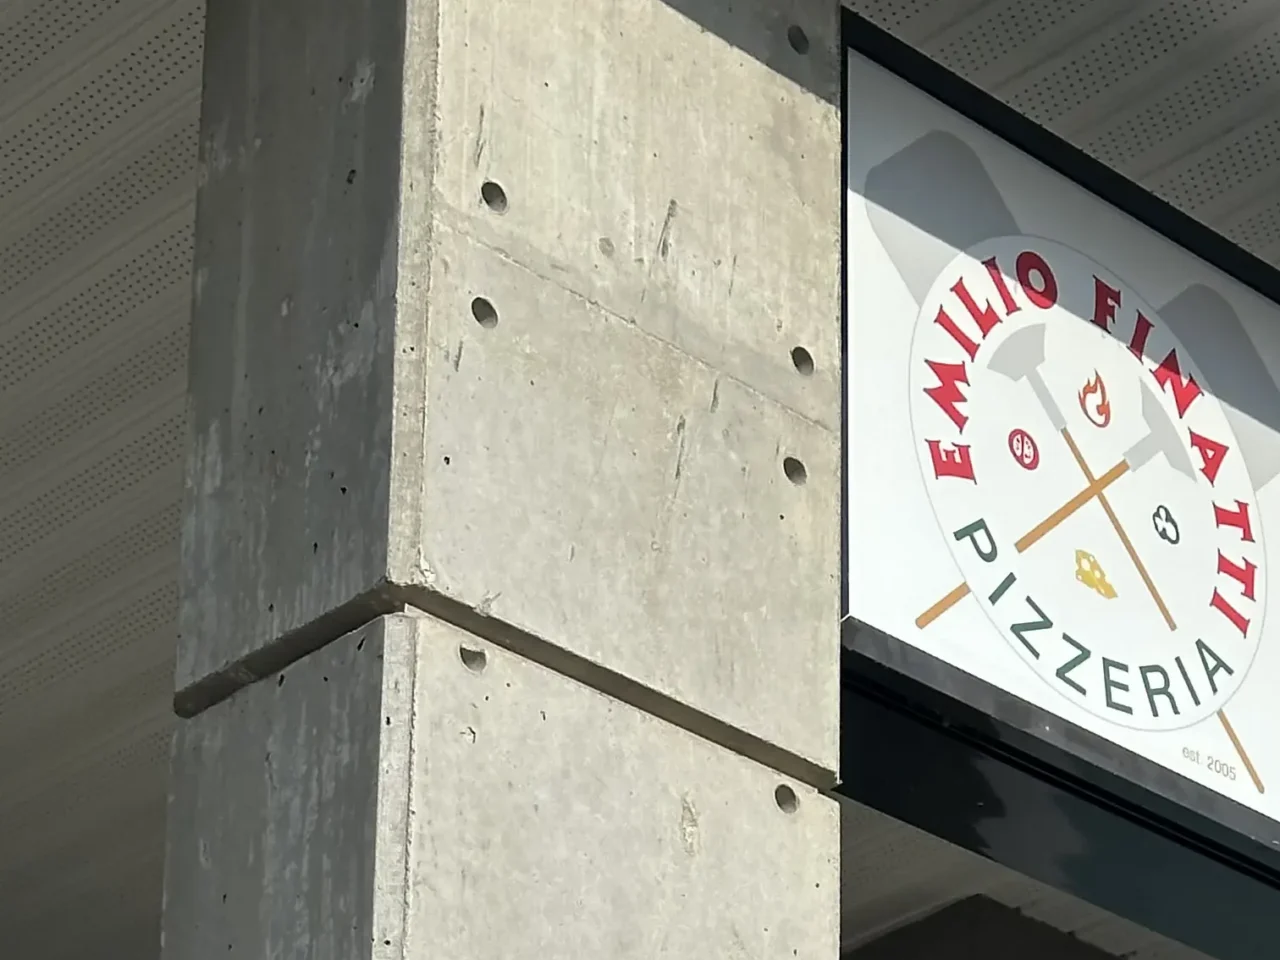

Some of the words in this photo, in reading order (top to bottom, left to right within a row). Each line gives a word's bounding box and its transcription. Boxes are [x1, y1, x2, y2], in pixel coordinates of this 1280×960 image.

[923, 251, 1058, 486] EMILIO
[1091, 274, 1257, 640] FINATTI
[953, 518, 1235, 718] PIZZERIA
[1206, 755, 1237, 781] 2005
